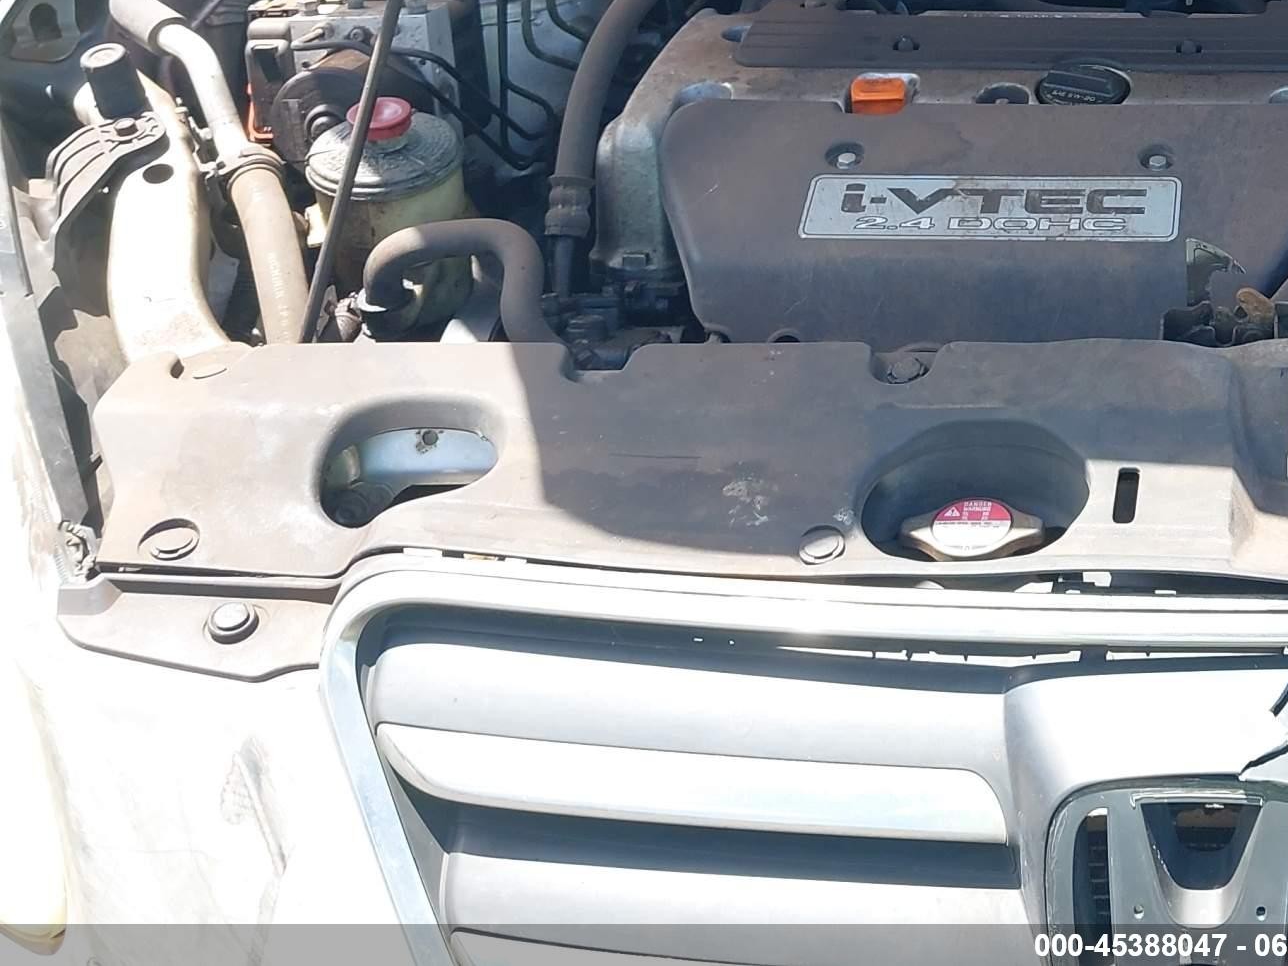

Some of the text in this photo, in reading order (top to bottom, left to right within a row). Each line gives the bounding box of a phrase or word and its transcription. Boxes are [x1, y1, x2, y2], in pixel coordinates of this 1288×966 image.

[840, 183, 1148, 215] i-VTEC
[854, 216, 1127, 232] 2.4 DOHC
